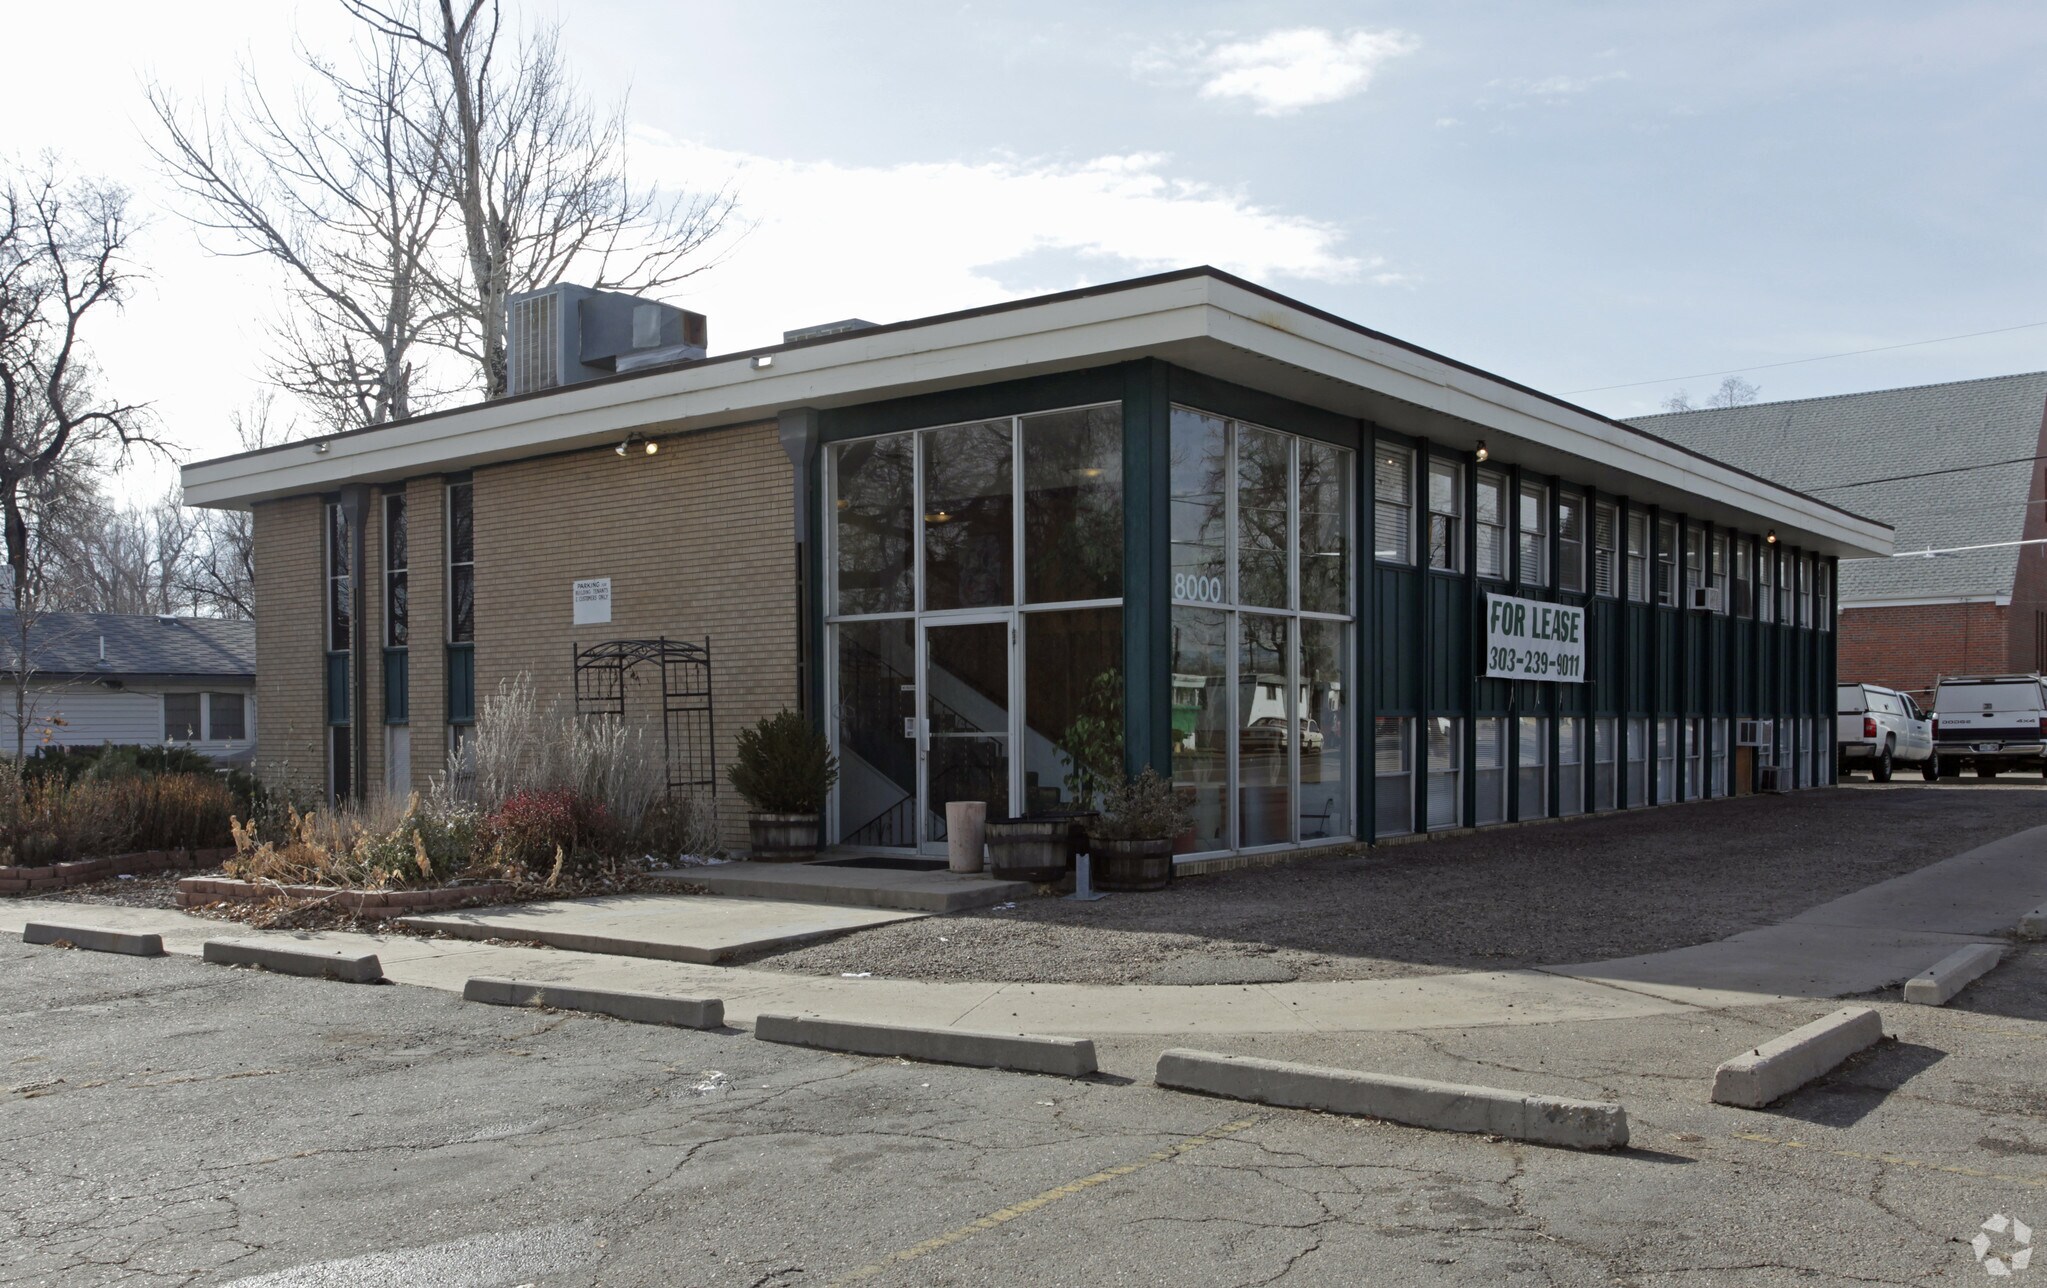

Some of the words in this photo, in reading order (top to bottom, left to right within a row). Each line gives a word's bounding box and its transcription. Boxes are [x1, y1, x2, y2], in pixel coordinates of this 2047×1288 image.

[577, 581, 600, 589] PARKING
[1174, 573, 1221, 603] 8000
[1491, 600, 1526, 637] FOR
[1532, 606, 1581, 643] LEASE
[1489, 646, 1580, 677] 303-239-9011
